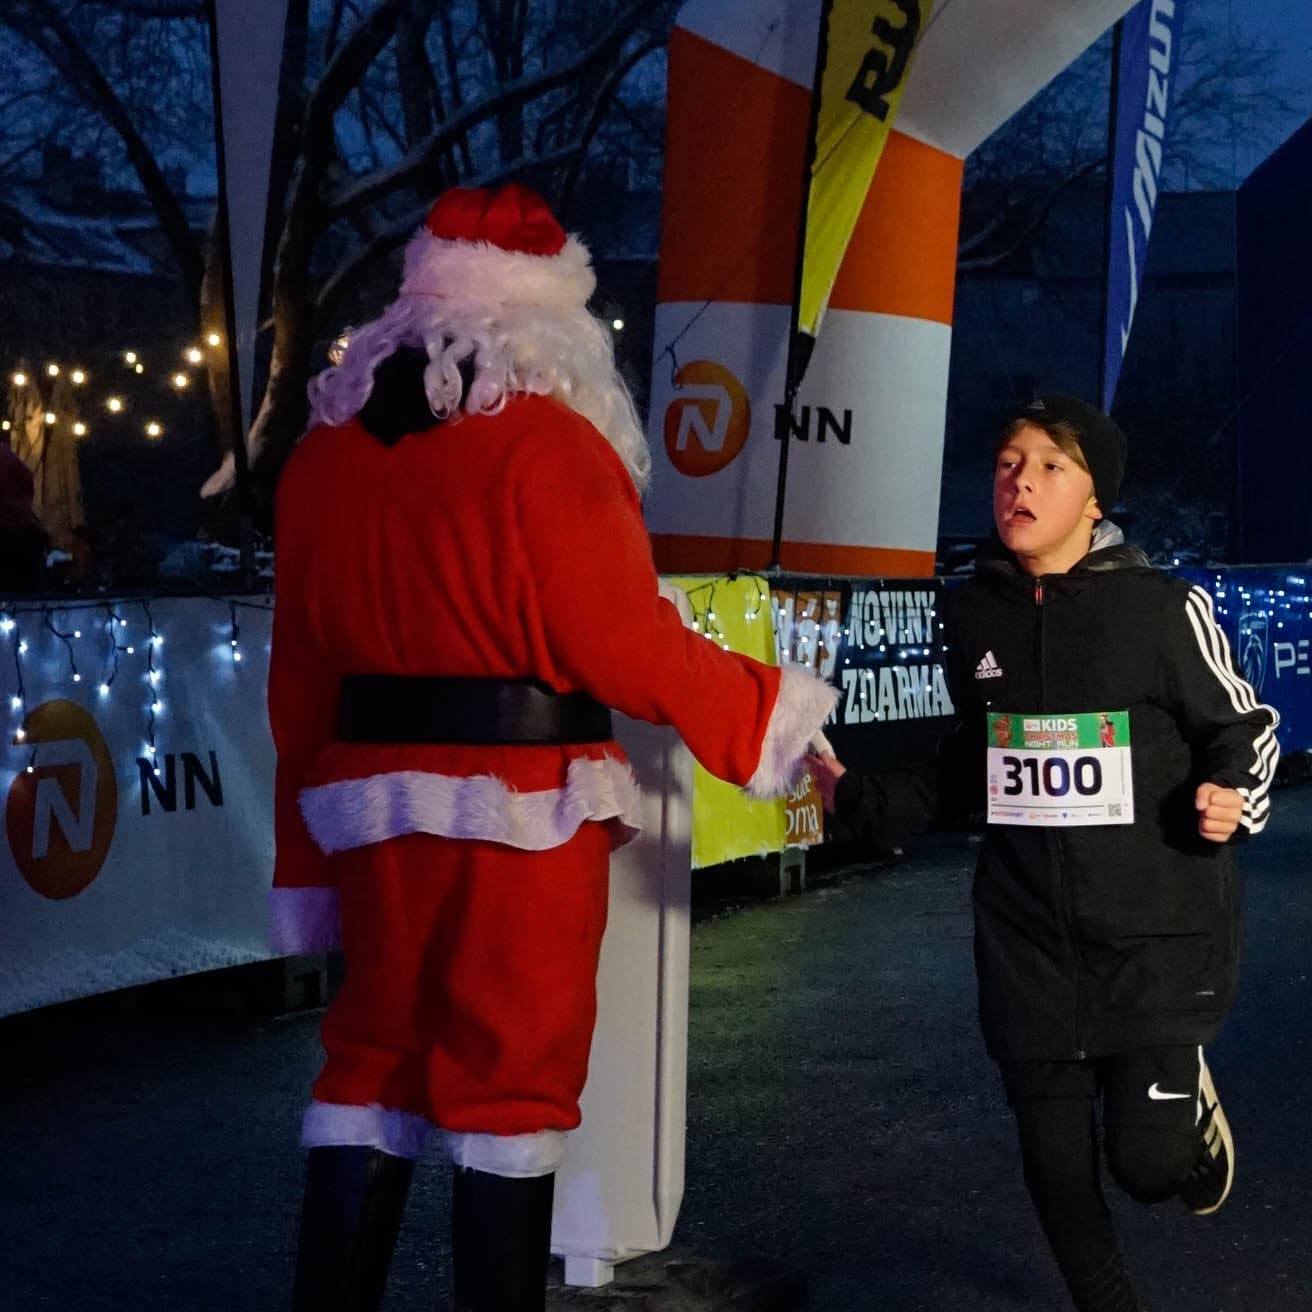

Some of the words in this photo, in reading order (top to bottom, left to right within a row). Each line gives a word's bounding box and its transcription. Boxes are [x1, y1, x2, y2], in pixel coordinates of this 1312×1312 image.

[774, 404, 852, 444] NN
[847, 590, 936, 646] NOVINY
[842, 664, 956, 724] ZDARMA
[1042, 718, 1078, 731] KIDS
[136, 750, 223, 816] NN
[1003, 756, 1102, 797] 3100
